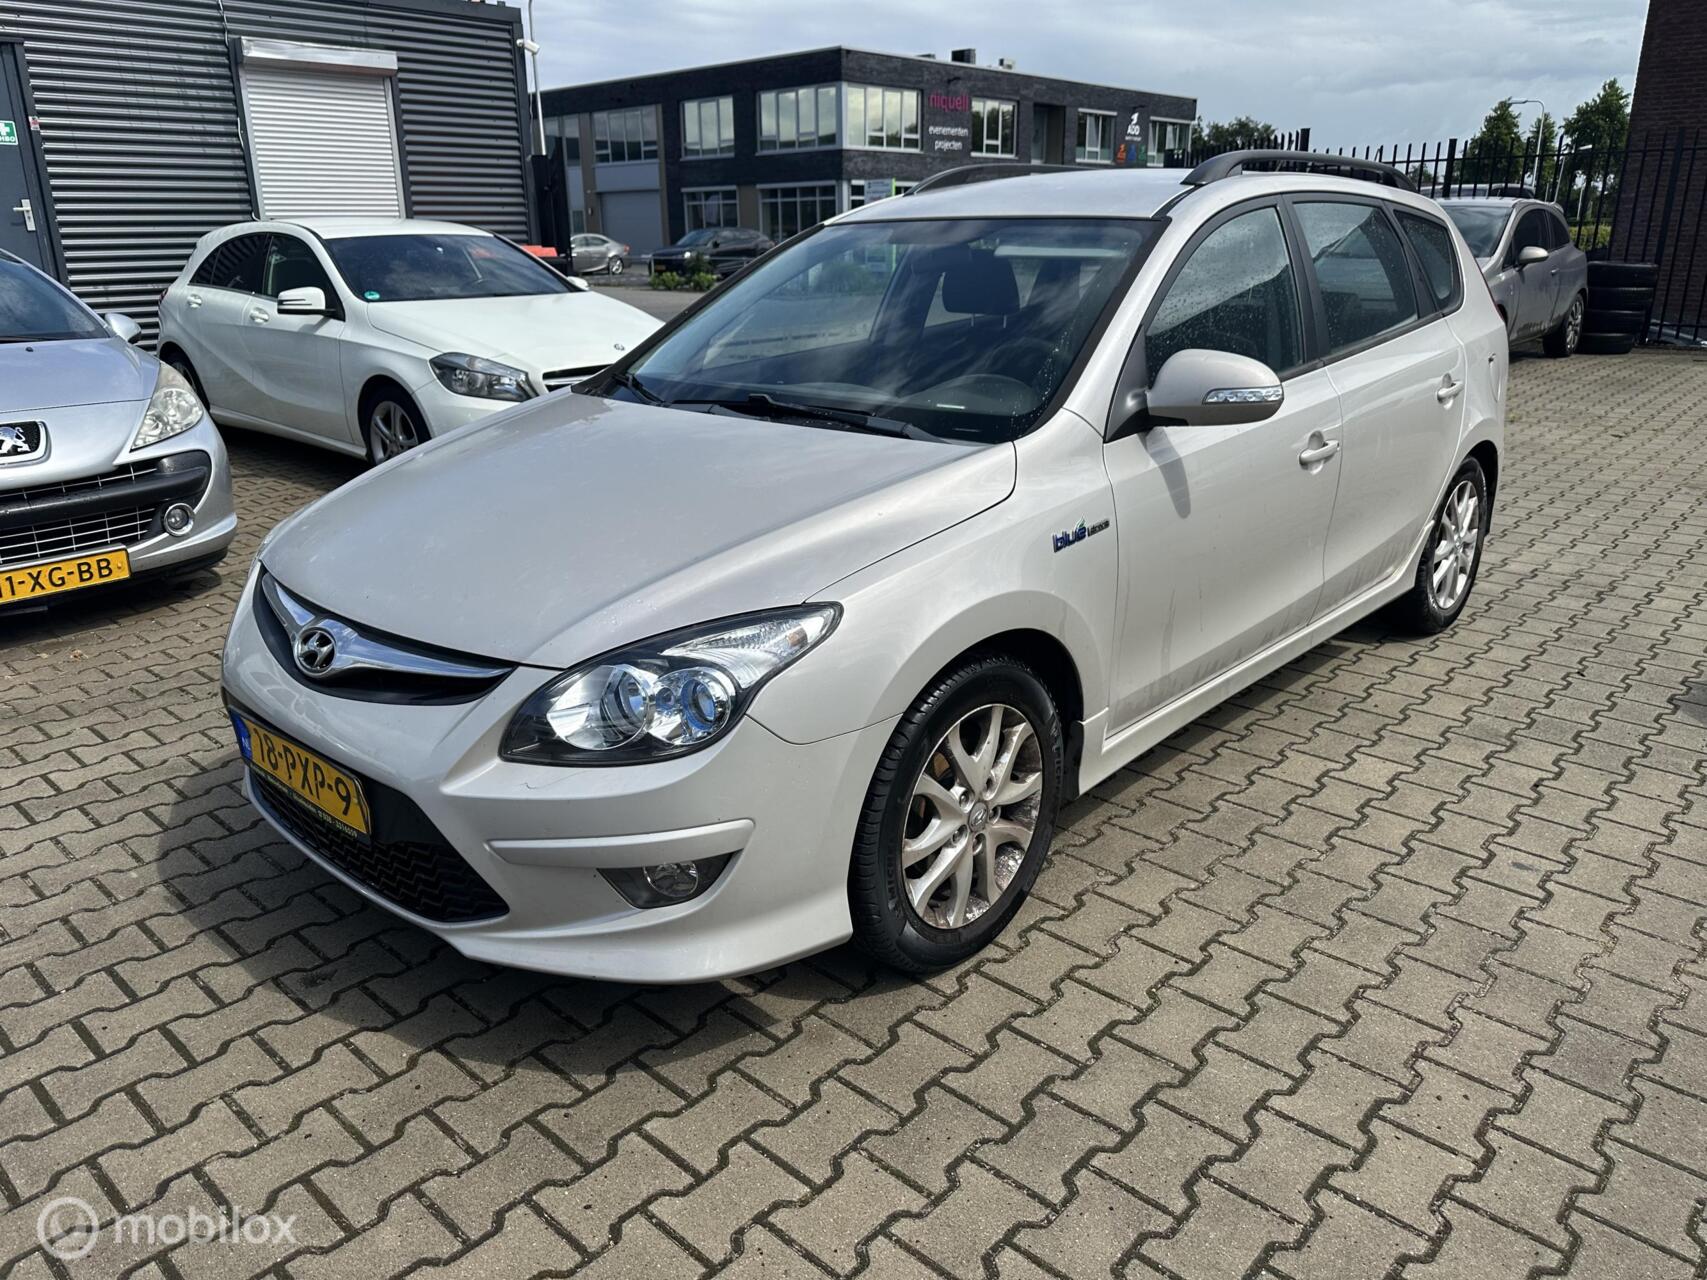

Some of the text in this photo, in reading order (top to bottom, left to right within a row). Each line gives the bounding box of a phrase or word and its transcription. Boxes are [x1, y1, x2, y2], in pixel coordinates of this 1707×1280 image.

[928, 126, 969, 137] evenementen
[934, 140, 963, 152] projecten
[253, 728, 352, 816] 18-PXP-9
